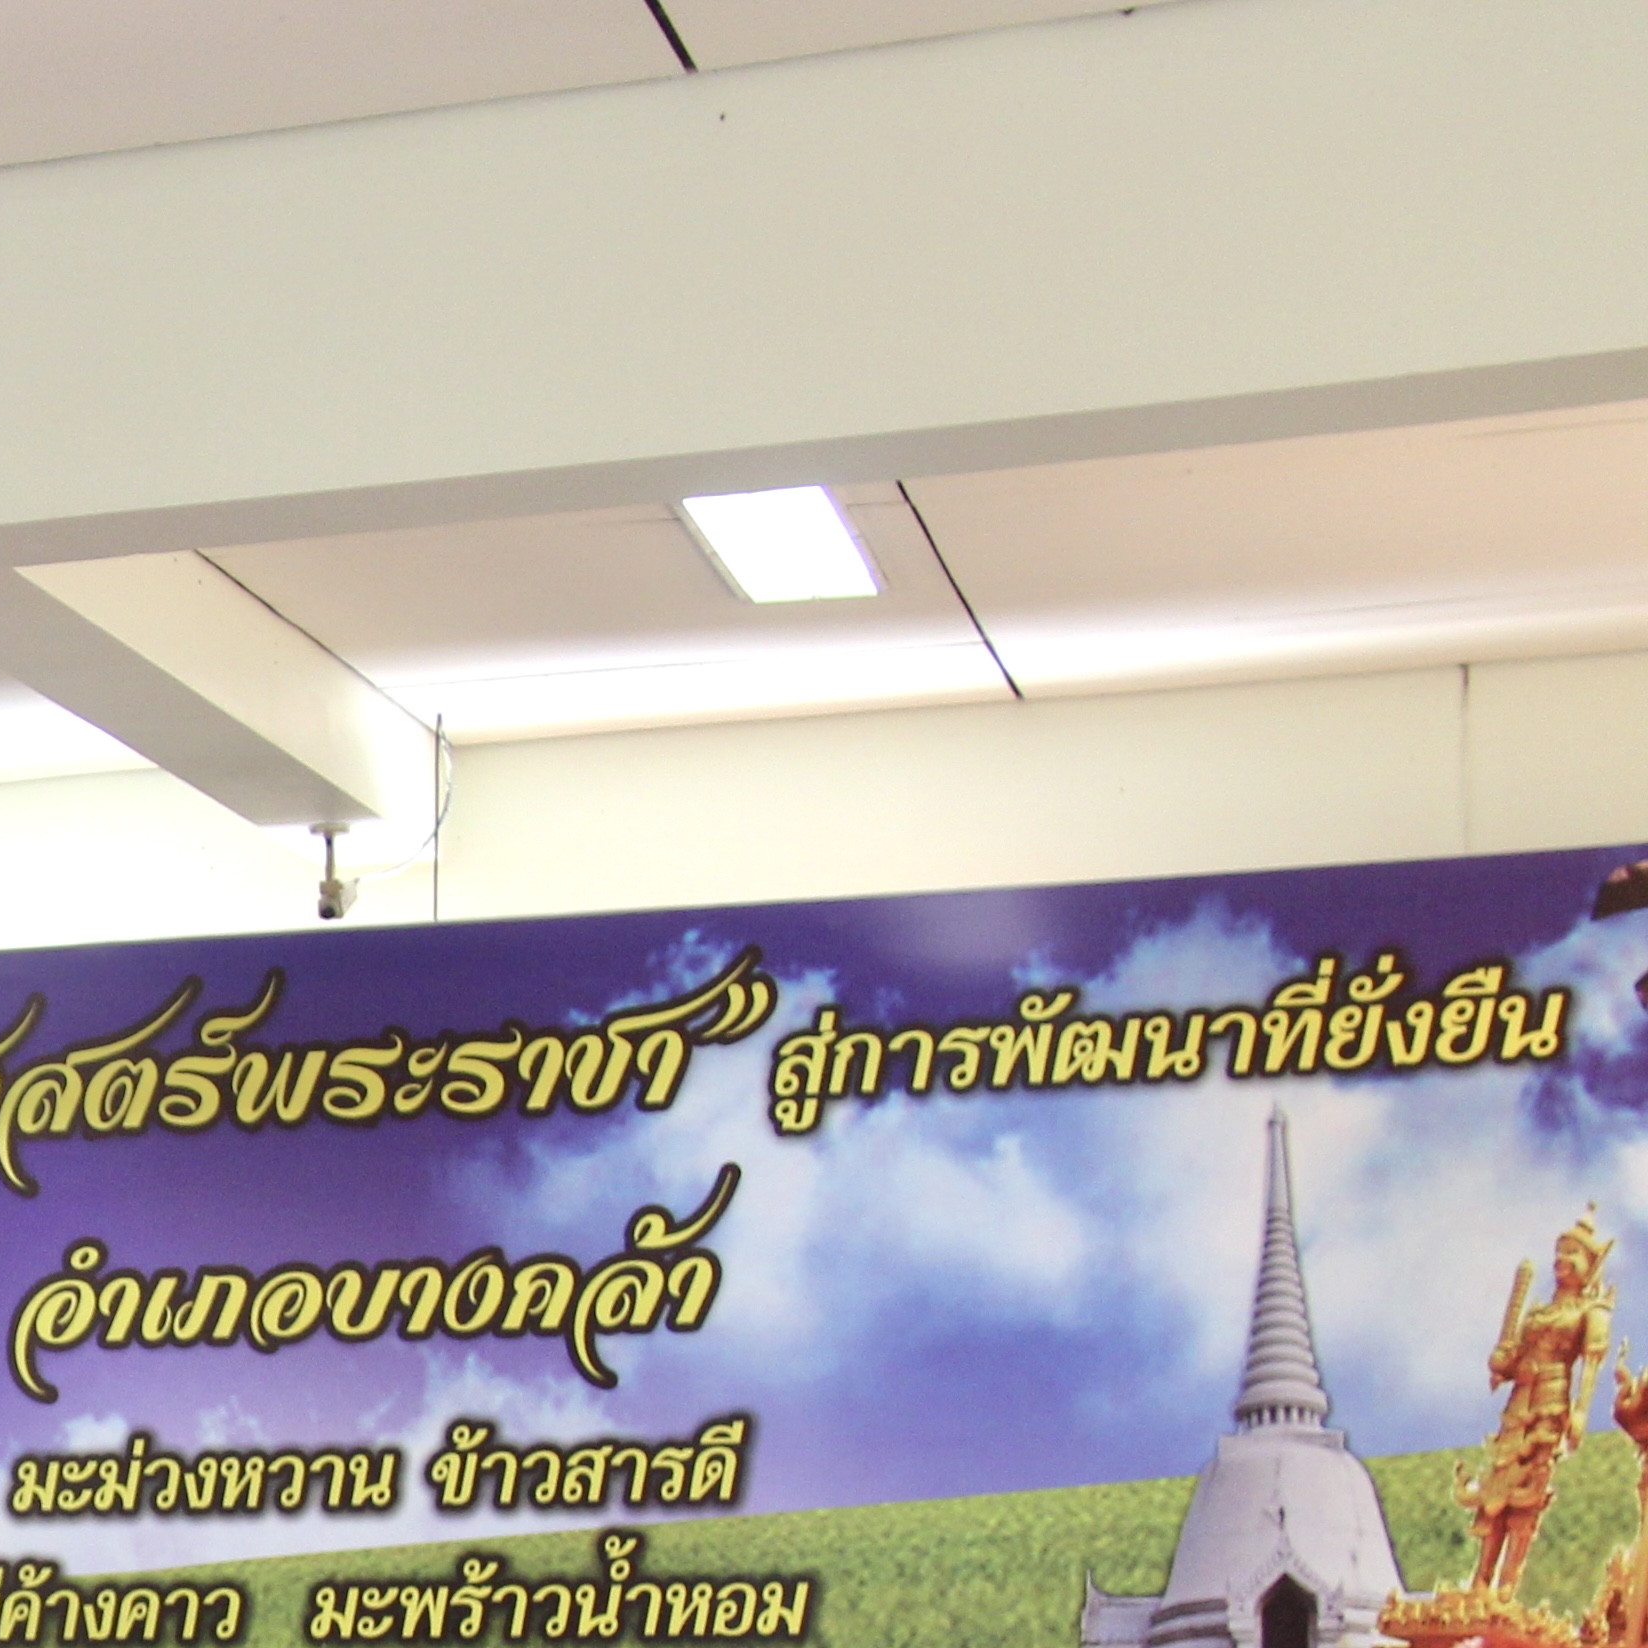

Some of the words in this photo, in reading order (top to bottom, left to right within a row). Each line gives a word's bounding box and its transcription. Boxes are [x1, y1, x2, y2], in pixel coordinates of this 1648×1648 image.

[773, 954, 1563, 1131] สู่การพัฒนาที่ยั่งยืน
[14, 1168, 734, 1393] อำเภอบางคล้า
[12, 1438, 395, 1512] มะม่วงหวาน
[431, 1420, 745, 1505] ข้าวสารดี
[310, 1536, 808, 1638] มะพร้าวน้ำหอม
